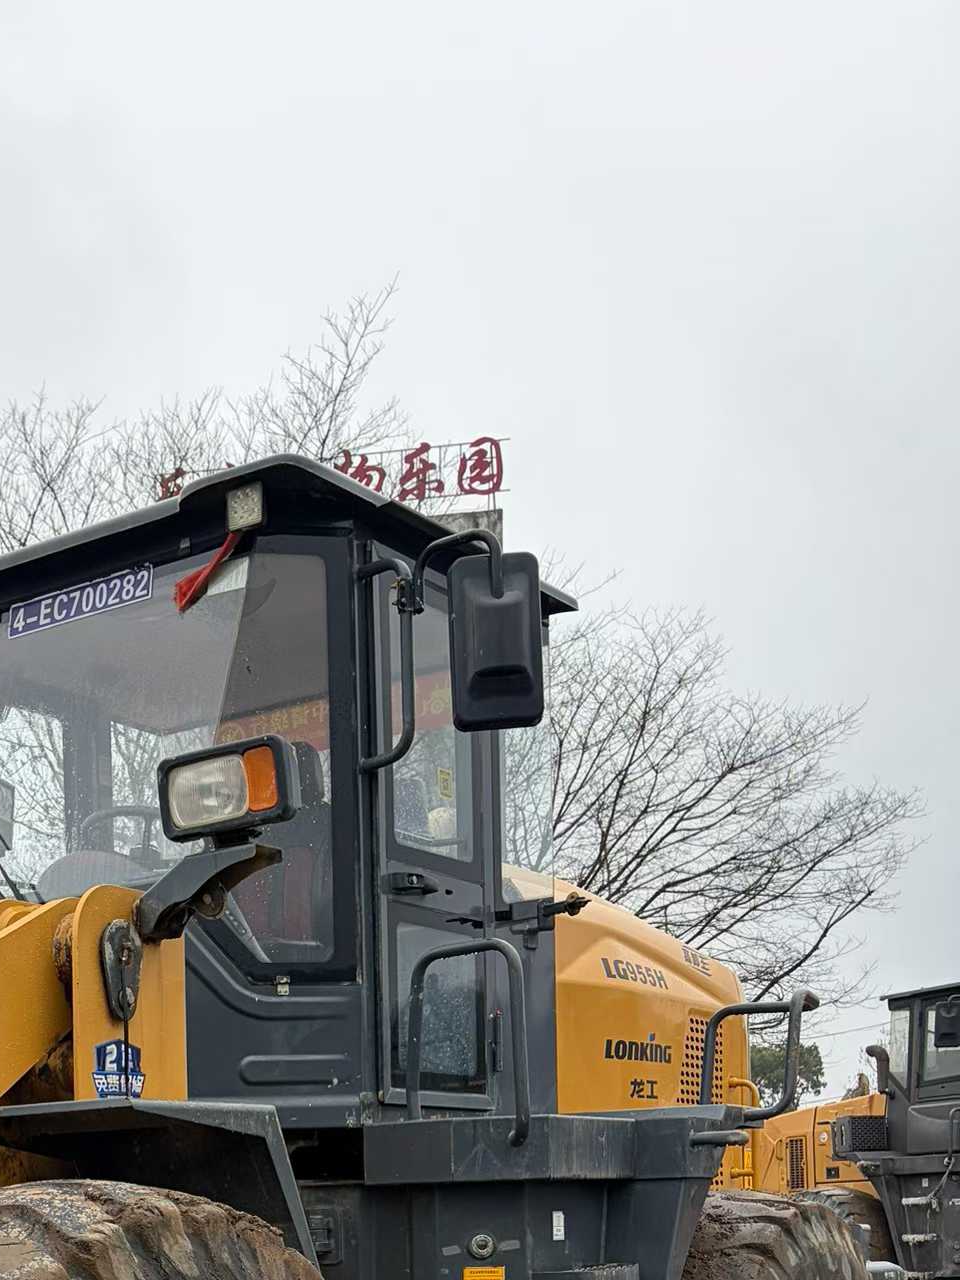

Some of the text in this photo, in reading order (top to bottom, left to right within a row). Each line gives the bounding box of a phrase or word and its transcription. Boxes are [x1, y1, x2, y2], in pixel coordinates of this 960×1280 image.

[13, 571, 148, 632] 4-EC700282
[601, 957, 669, 990] LG955H
[630, 1078, 658, 1099] 龙工
